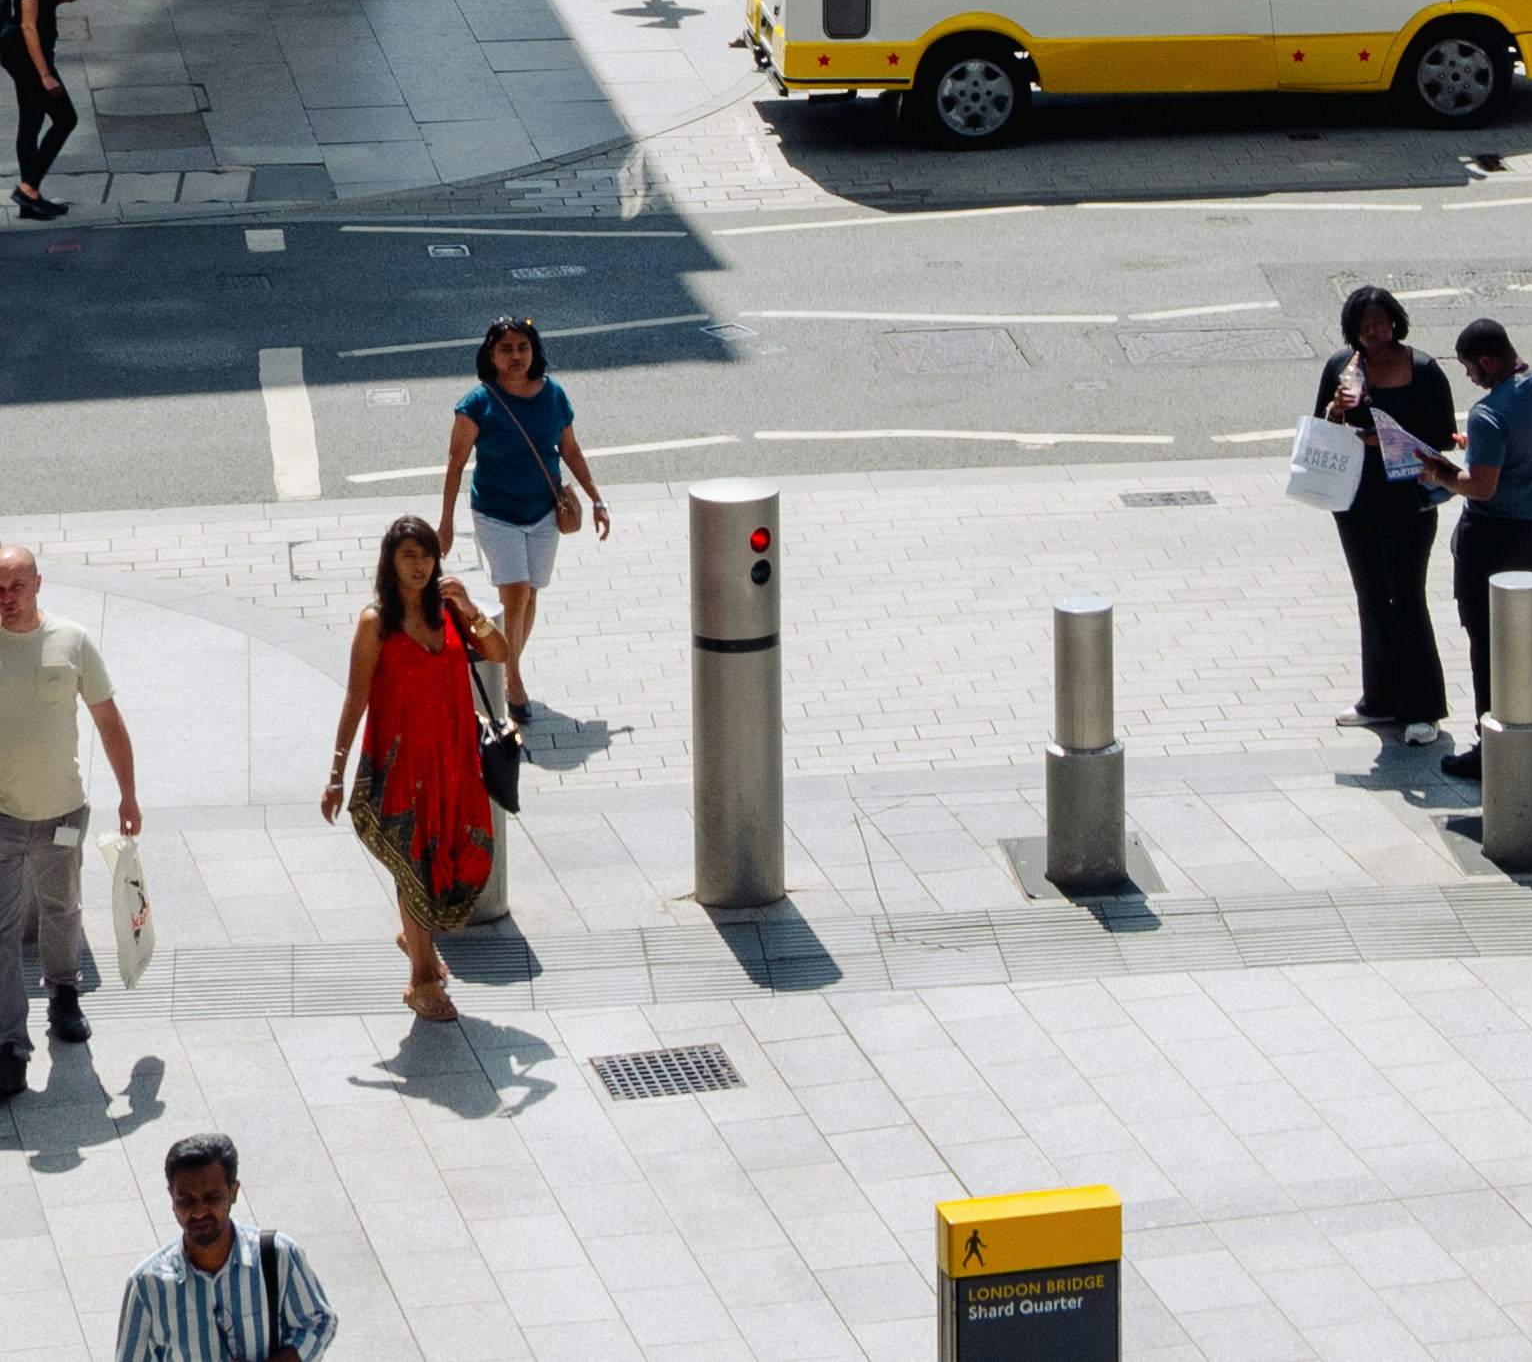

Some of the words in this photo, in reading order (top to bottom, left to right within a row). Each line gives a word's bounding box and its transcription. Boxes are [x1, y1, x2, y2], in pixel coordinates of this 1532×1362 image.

[1302, 455, 1346, 473] AHEAD
[1306, 446, 1349, 464] BREAD
[968, 1283, 1041, 1301] LONDON
[1046, 1275, 1105, 1294] BRIDGE
[968, 1301, 1014, 1321] Shard
[1020, 1296, 1084, 1315] Quarter
